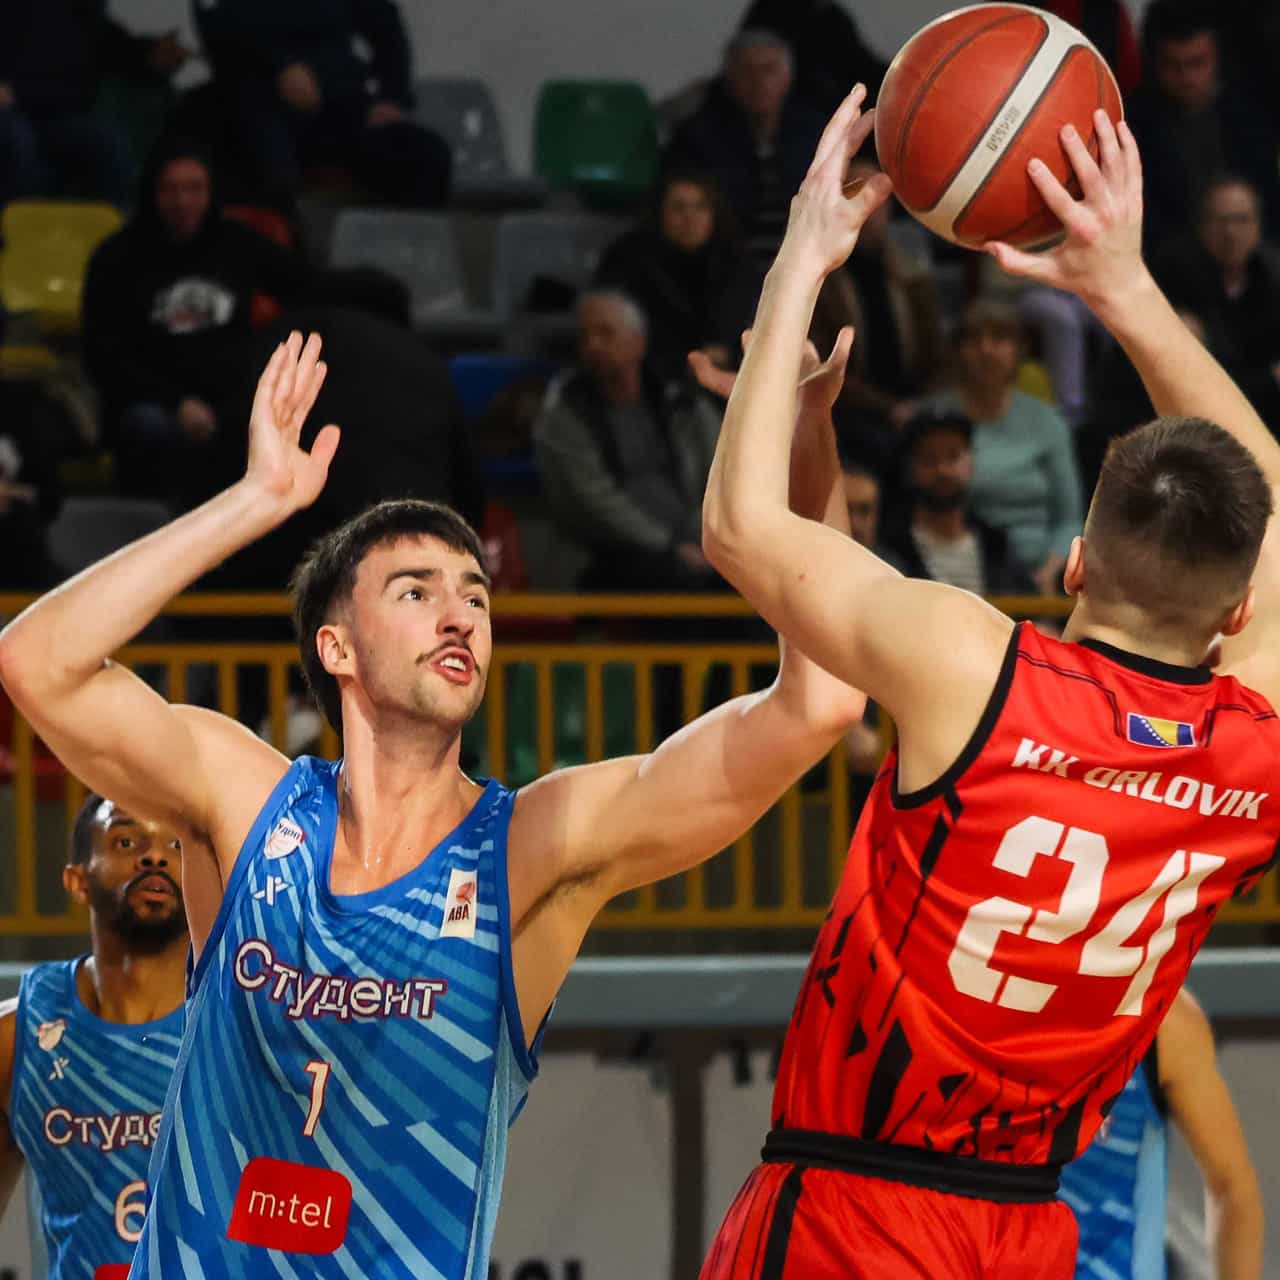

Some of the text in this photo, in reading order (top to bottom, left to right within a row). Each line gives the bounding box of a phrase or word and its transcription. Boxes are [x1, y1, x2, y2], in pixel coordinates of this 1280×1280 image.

[1011, 738, 1269, 820] KK ORLOVIK
[947, 815, 1227, 1018] 24
[233, 938, 451, 1022] Студент
[302, 1058, 332, 1138] 1
[114, 1179, 148, 1243] 6
[247, 1189, 334, 1229] m:tel
